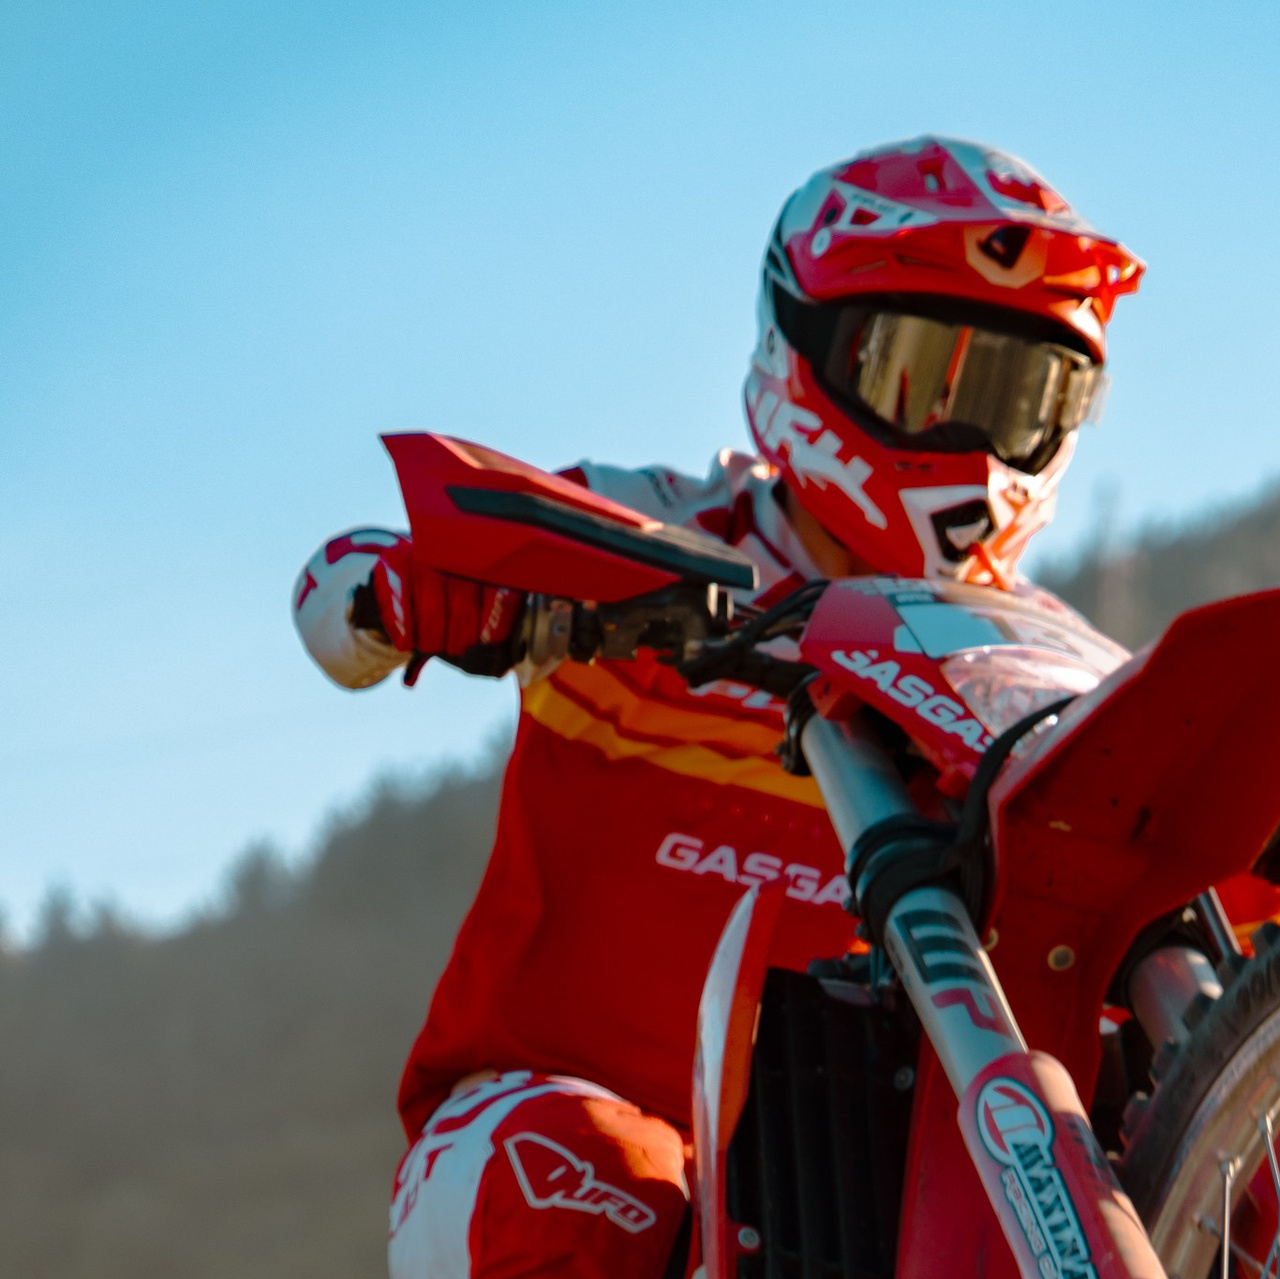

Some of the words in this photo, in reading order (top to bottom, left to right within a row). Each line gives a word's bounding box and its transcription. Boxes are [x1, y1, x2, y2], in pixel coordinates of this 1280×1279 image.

[831, 649, 995, 754] GASGA
[655, 832, 851, 905] GASGA
[1005, 1165, 1048, 1252] RACING
